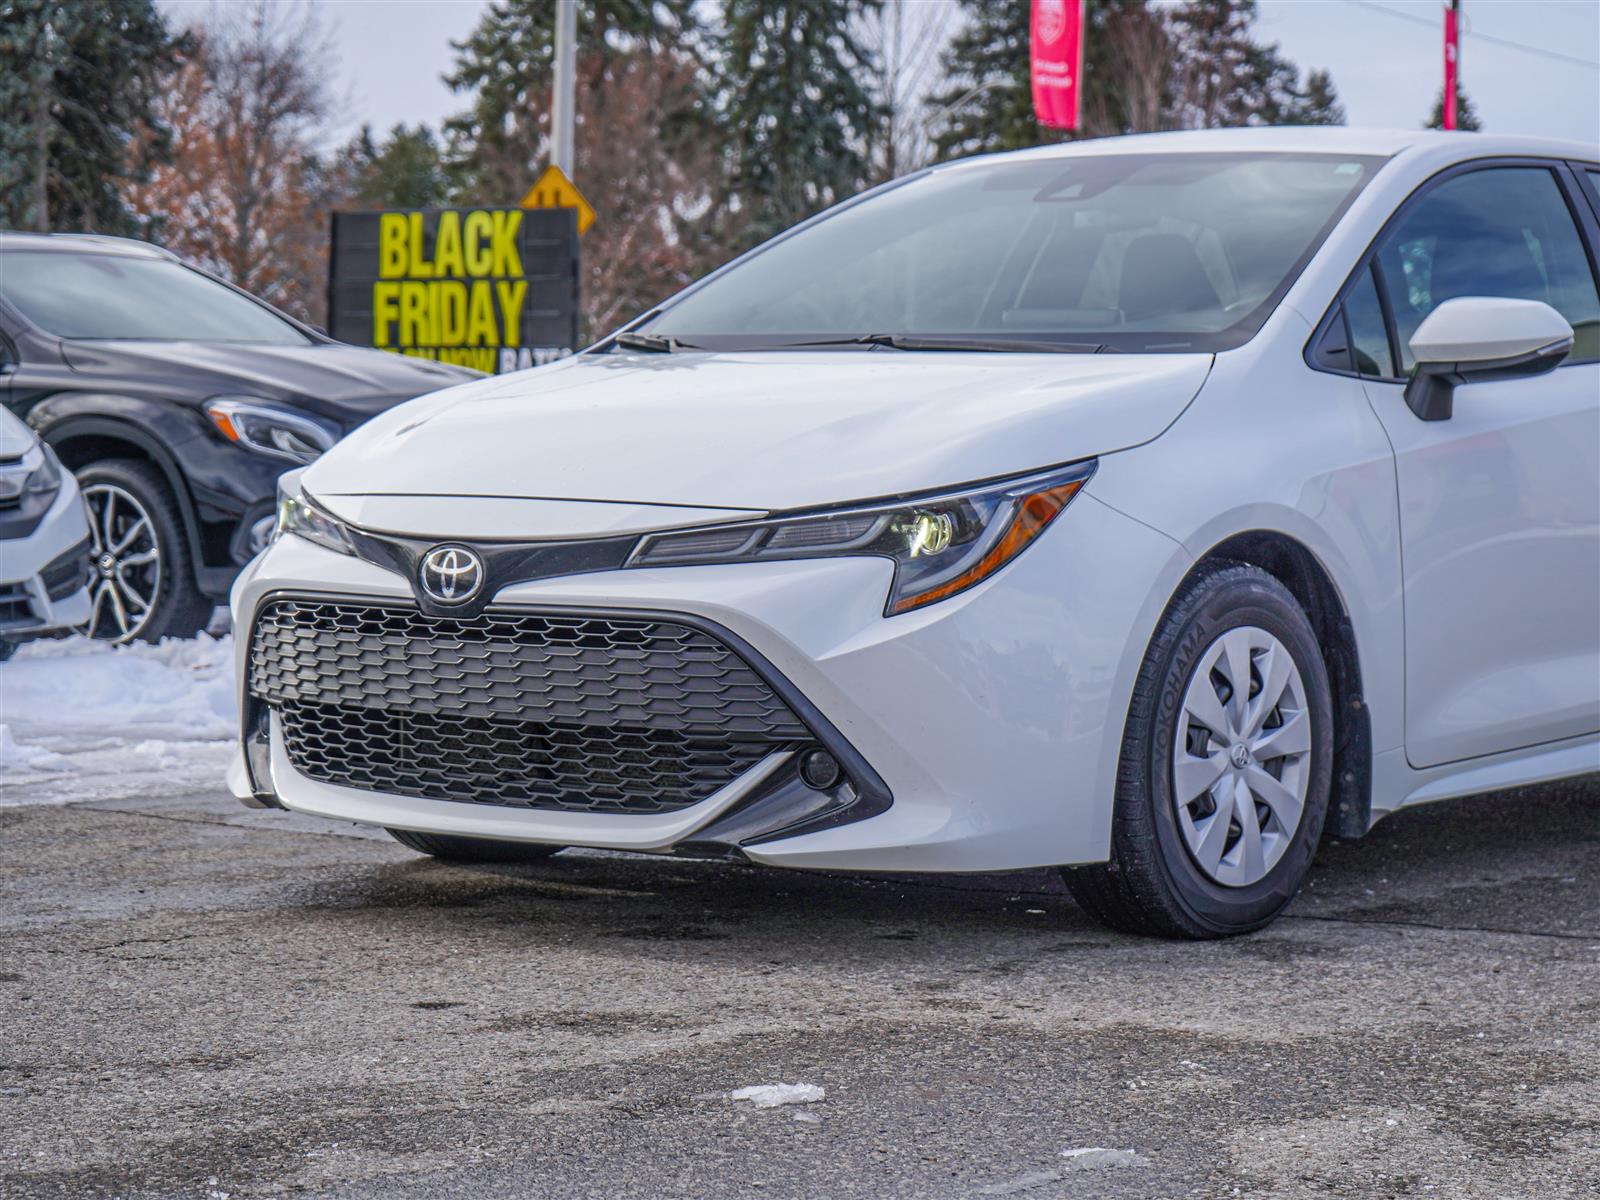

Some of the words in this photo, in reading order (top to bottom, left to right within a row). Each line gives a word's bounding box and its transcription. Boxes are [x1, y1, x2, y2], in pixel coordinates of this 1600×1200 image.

[379, 211, 524, 278] BLACK
[373, 281, 528, 346] FRIDAY
[1153, 621, 1206, 761] YOKOHAMA
